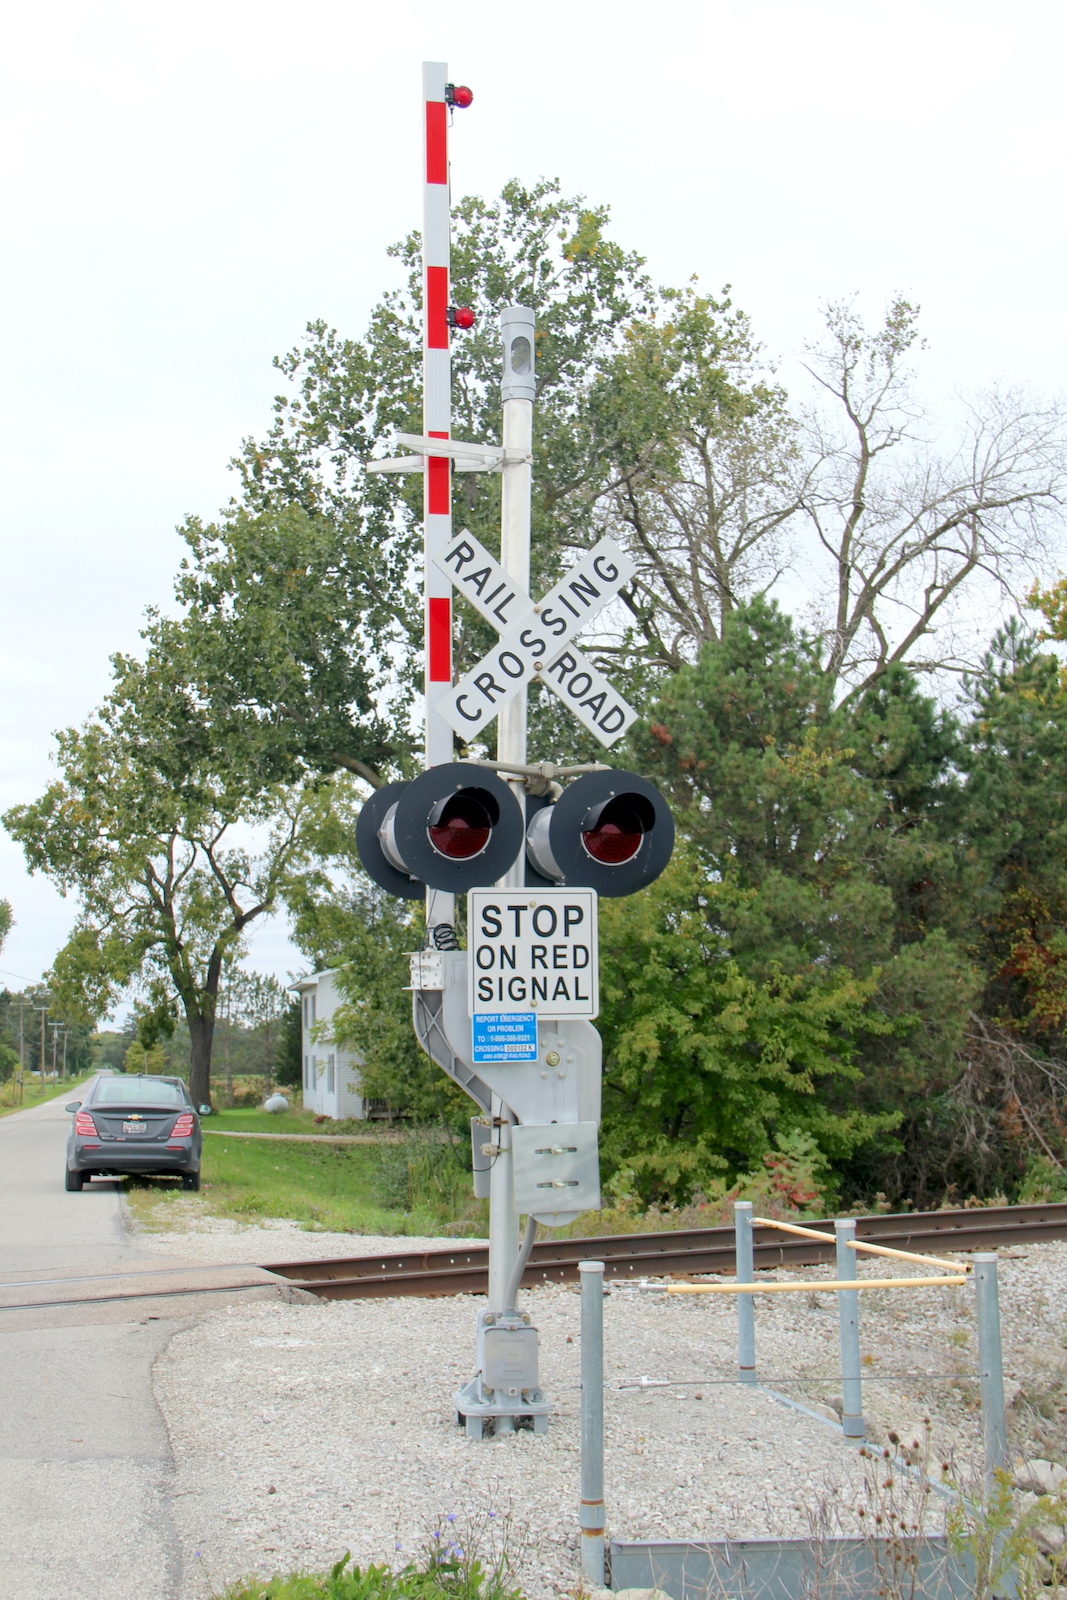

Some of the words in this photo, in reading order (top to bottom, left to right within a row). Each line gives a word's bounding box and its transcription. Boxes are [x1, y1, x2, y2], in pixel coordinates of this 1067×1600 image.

[444, 540, 516, 625] RAIL
[547, 651, 625, 734] ROAD
[455, 556, 619, 722] CROSSING
[481, 904, 584, 938] STOP
[476, 945, 516, 970] ON
[531, 945, 589, 969] RED
[478, 976, 589, 1002] SIGNAL
[475, 1015, 499, 1023] REPORT
[500, 1014, 535, 1022] EMERGENCY
[497, 1024, 524, 1032] PROBLEM
